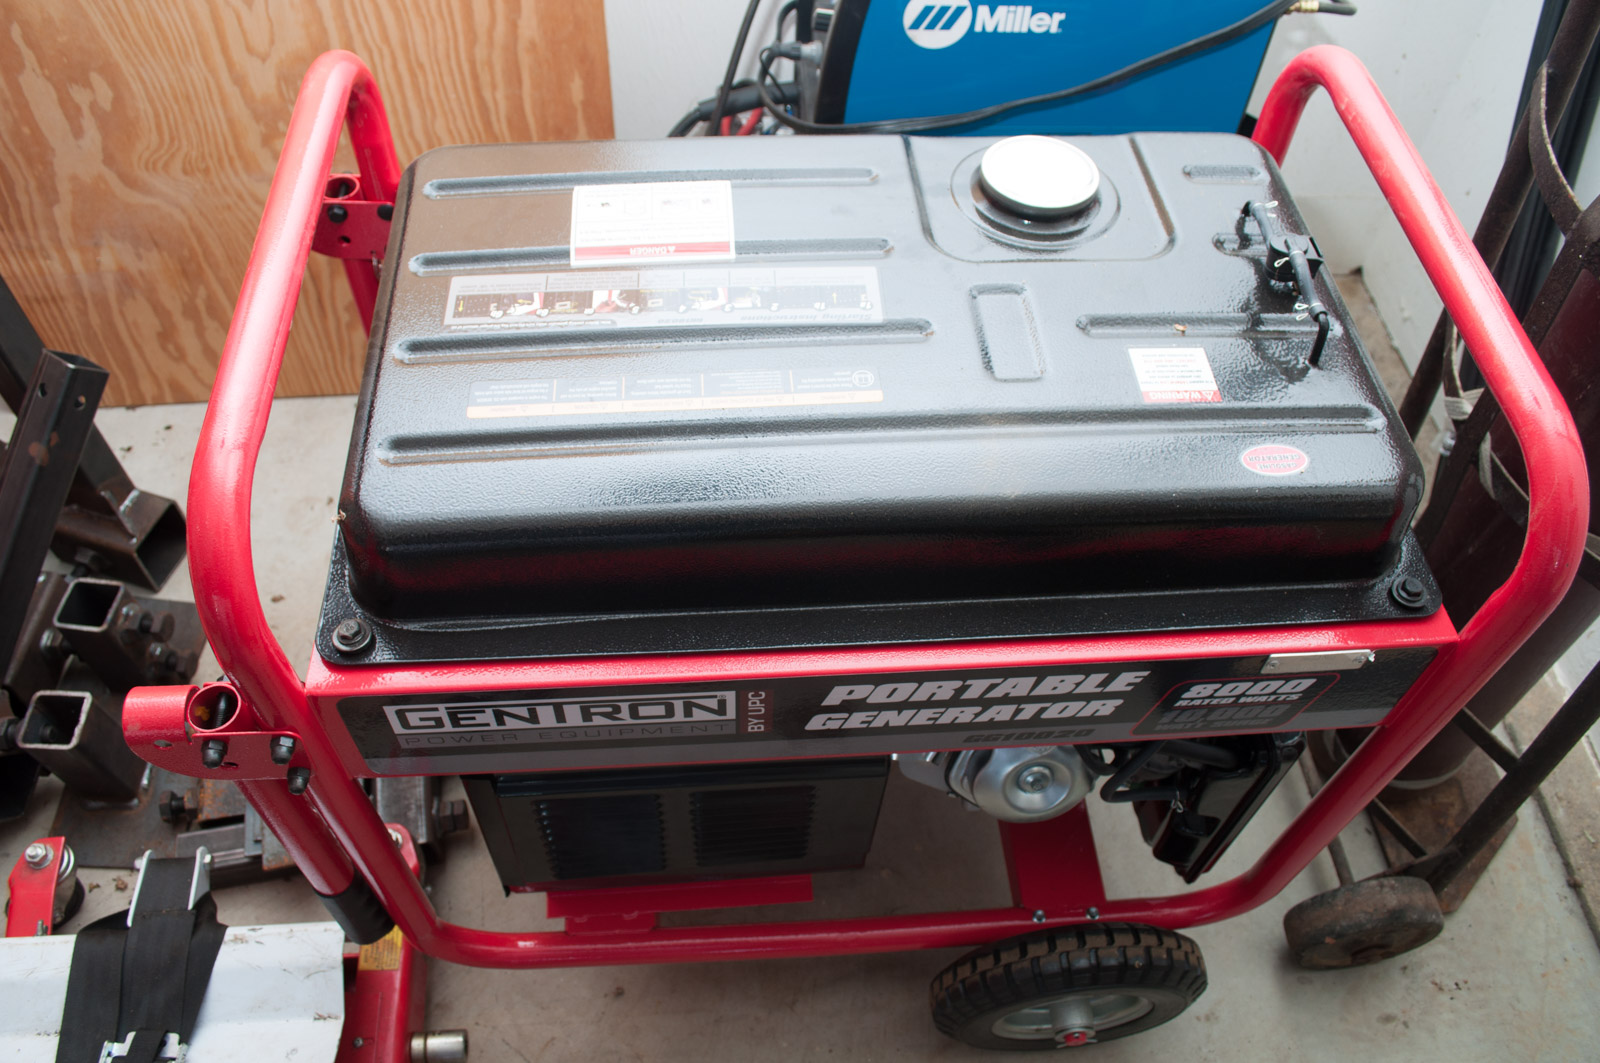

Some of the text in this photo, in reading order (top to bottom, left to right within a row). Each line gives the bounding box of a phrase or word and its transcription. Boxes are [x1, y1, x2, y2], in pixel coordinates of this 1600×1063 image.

[974, 5, 1066, 34] Miller
[630, 246, 667, 255] DANGER
[740, 314, 817, 322] Instructions
[822, 313, 872, 322] Starting
[1149, 391, 1202, 400] WARNING
[1247, 454, 1300, 463] GENERATOR
[1257, 462, 1298, 470] GASOLINE
[820, 671, 1151, 707] PORTABLE
[1180, 678, 1318, 699] 8000
[1173, 693, 1303, 707] RATED WATTS
[395, 695, 728, 731] GENTRON
[747, 691, 765, 733] BY UPC
[804, 699, 1124, 731] GENERATOR
[1157, 704, 1292, 725] 10,000
[1154, 718, 1274, 731] WATT SURGE
[404, 723, 732, 747] POWER EQUIPMENT
